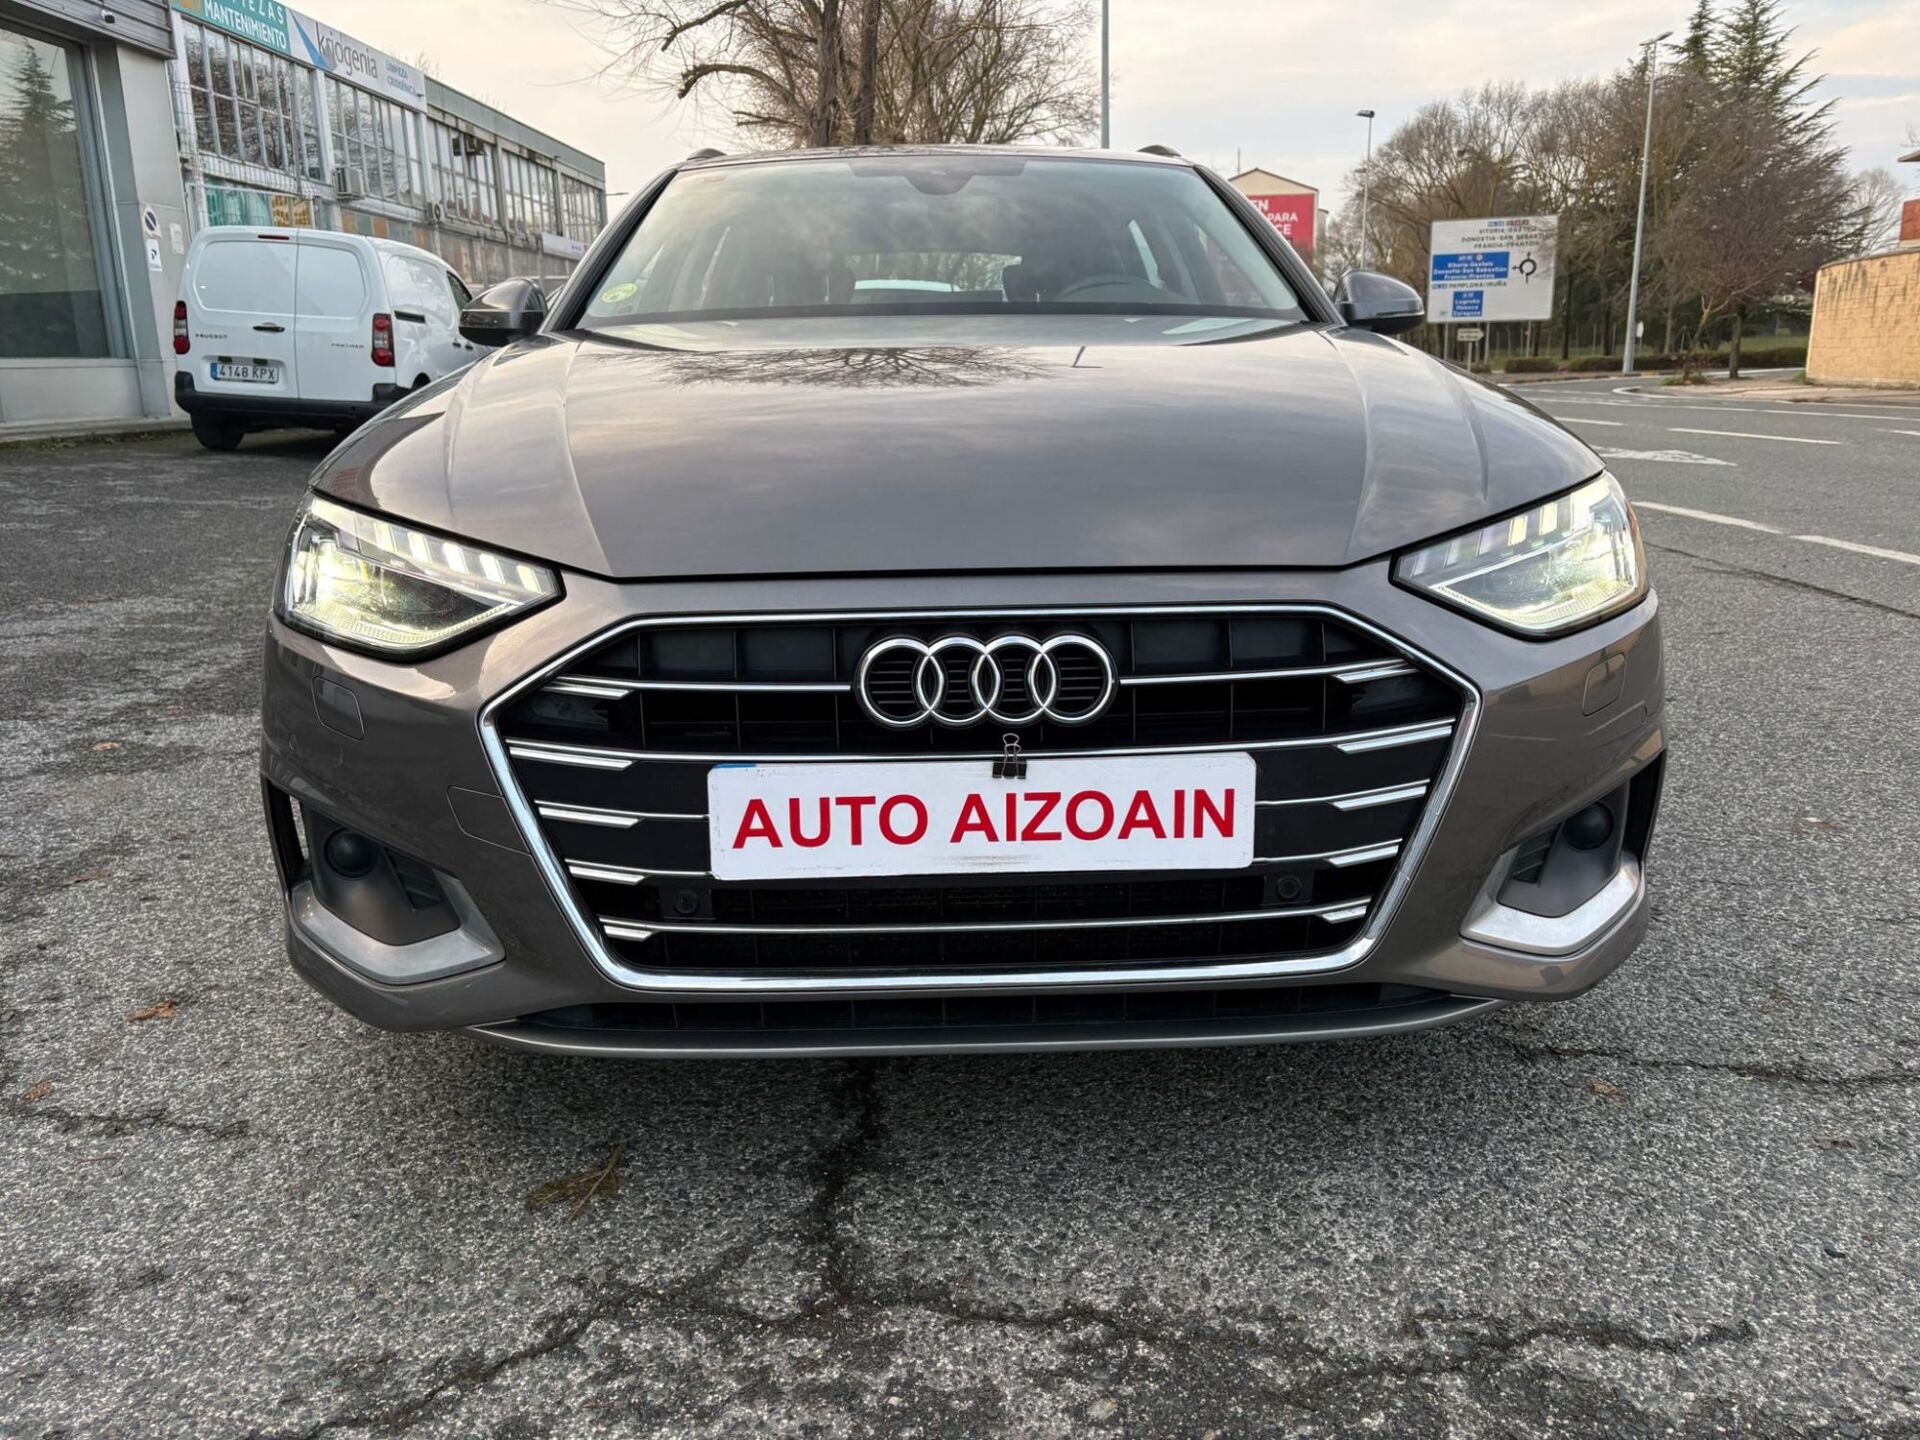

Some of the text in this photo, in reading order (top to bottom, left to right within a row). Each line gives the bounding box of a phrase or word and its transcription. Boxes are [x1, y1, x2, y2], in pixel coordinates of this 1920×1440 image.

[204, 0, 287, 50] MANTENIMIENTO
[1267, 212, 1298, 223] PARA
[218, 366, 276, 380] 4148 KPX
[732, 788, 1235, 849] AUTO AIZOAIN
